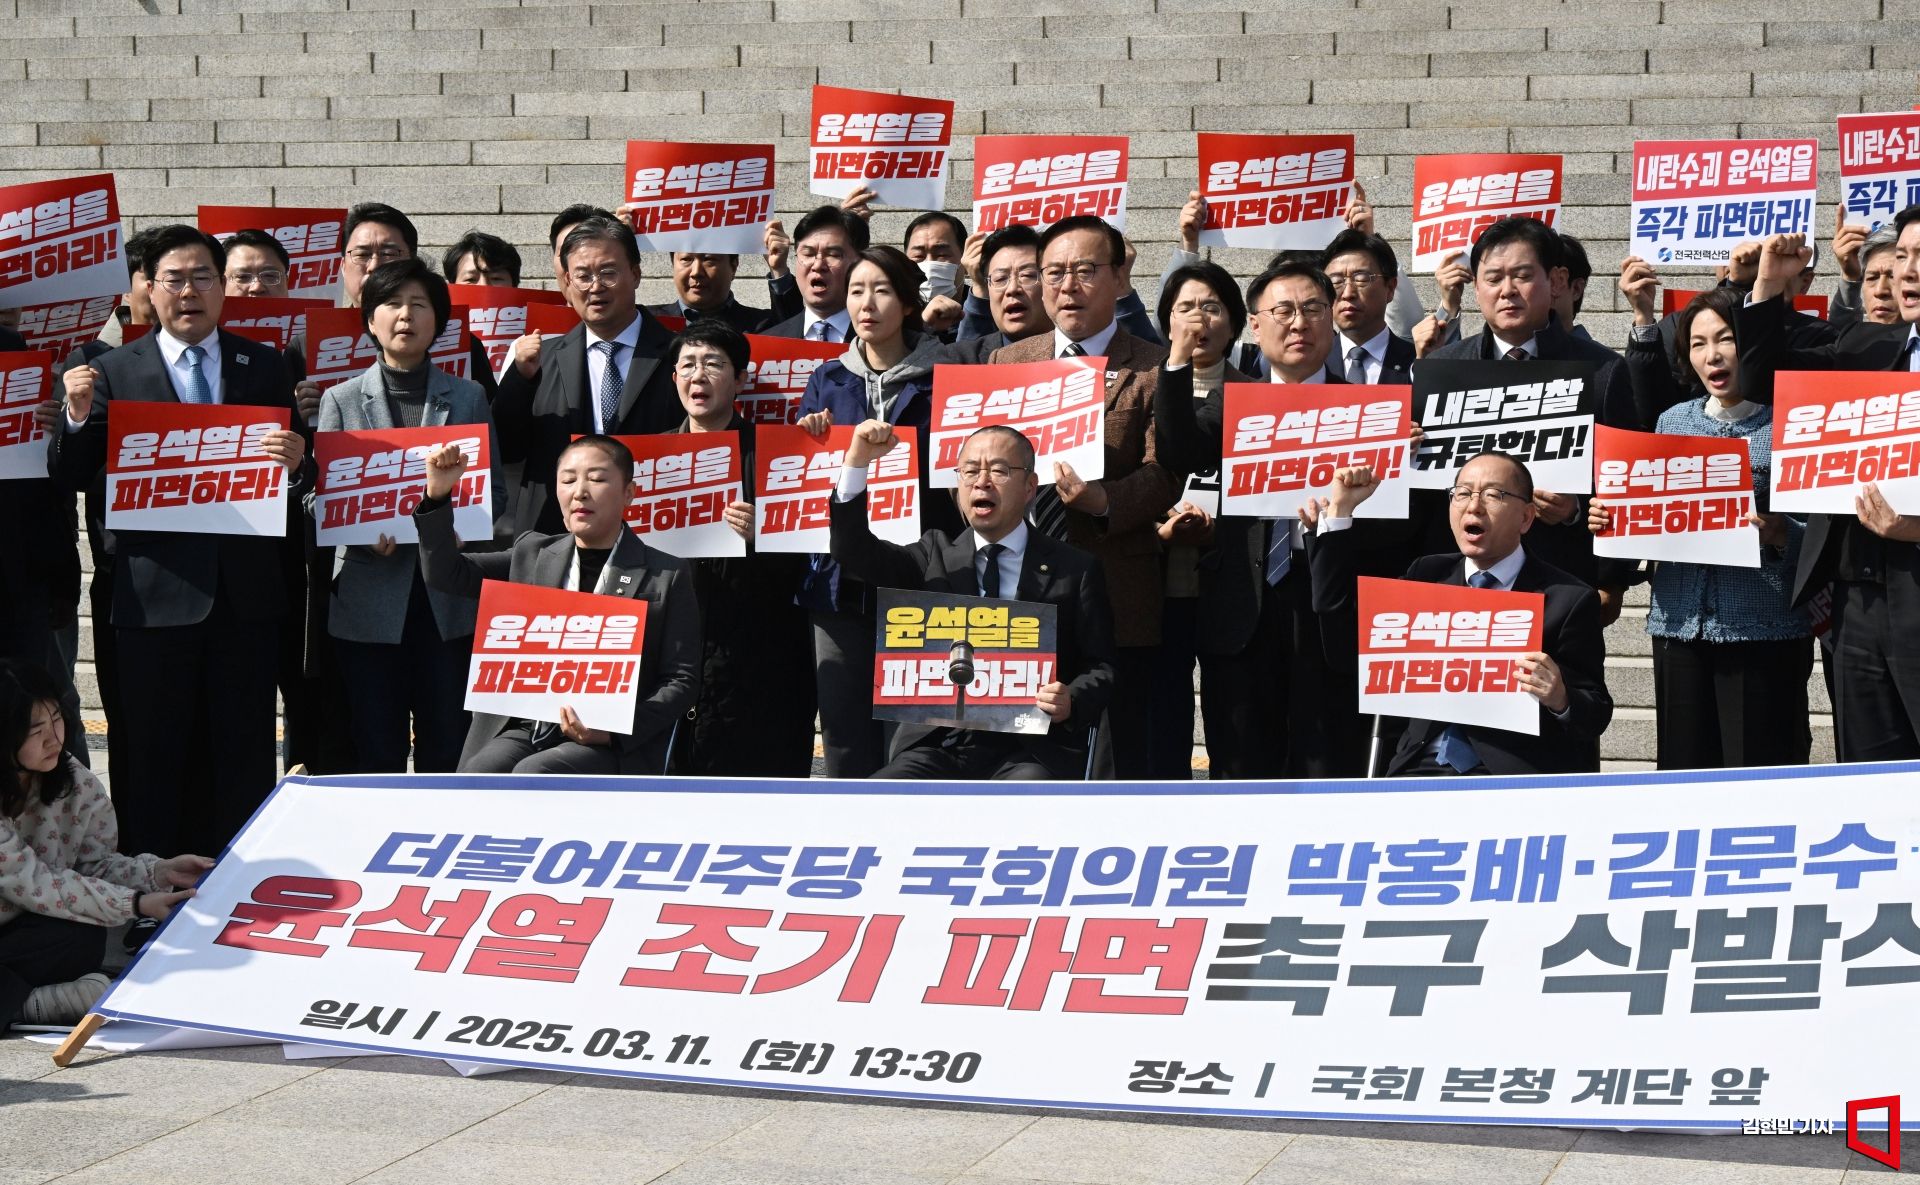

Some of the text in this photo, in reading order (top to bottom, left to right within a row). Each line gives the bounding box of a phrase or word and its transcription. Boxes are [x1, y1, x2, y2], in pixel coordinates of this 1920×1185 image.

[816, 113, 945, 142] 윤석열을
[632, 157, 767, 198] 윤석열을
[813, 151, 945, 179] 파면하라!
[981, 149, 1121, 195] 윤석열을
[1207, 149, 1347, 192] 윤석열을
[1637, 144, 1812, 191] 내란수괴 윤석열을
[631, 194, 770, 235] 파면하라!
[977, 188, 1122, 232] 파면하라!
[1203, 187, 1350, 230] 파면하라!
[1419, 169, 1554, 216] 윤석열을
[1848, 180, 1897, 217] 즉각
[1636, 198, 1812, 242] 즉각 파면하라!
[941, 367, 1096, 427] 윤석열을
[1421, 378, 1585, 427] 내란검찰
[117, 422, 282, 468] 윤석열을
[1233, 400, 1402, 452] 윤석열을
[1415, 425, 1589, 471] 규탄한다!
[765, 442, 911, 491] 윤석을
[1598, 453, 1742, 495] 윤석열을
[111, 466, 283, 512] 파면하라!
[483, 615, 639, 650] 윤석열을
[885, 607, 1040, 648] 윤석열을
[1369, 610, 1534, 648] 윤석열을
[472, 660, 636, 694] 파면하라!
[881, 658, 1053, 697] 파면하라!
[363, 831, 882, 900] 더불어민주당
[899, 845, 1258, 907] 국회의원
[214, 875, 614, 984] 윤석열
[620, 903, 905, 1003] 조기
[299, 999, 408, 1036] 일시
[740, 1038, 835, 1074] (화)
[849, 1046, 982, 1083] 13:30
[1127, 1060, 1234, 1095] 장소
[1311, 1065, 1424, 1102] 국회
[1439, 1067, 1555, 1105] 본청
[1570, 1068, 1692, 1106] 계단
[1708, 1067, 1770, 1106] 앞
